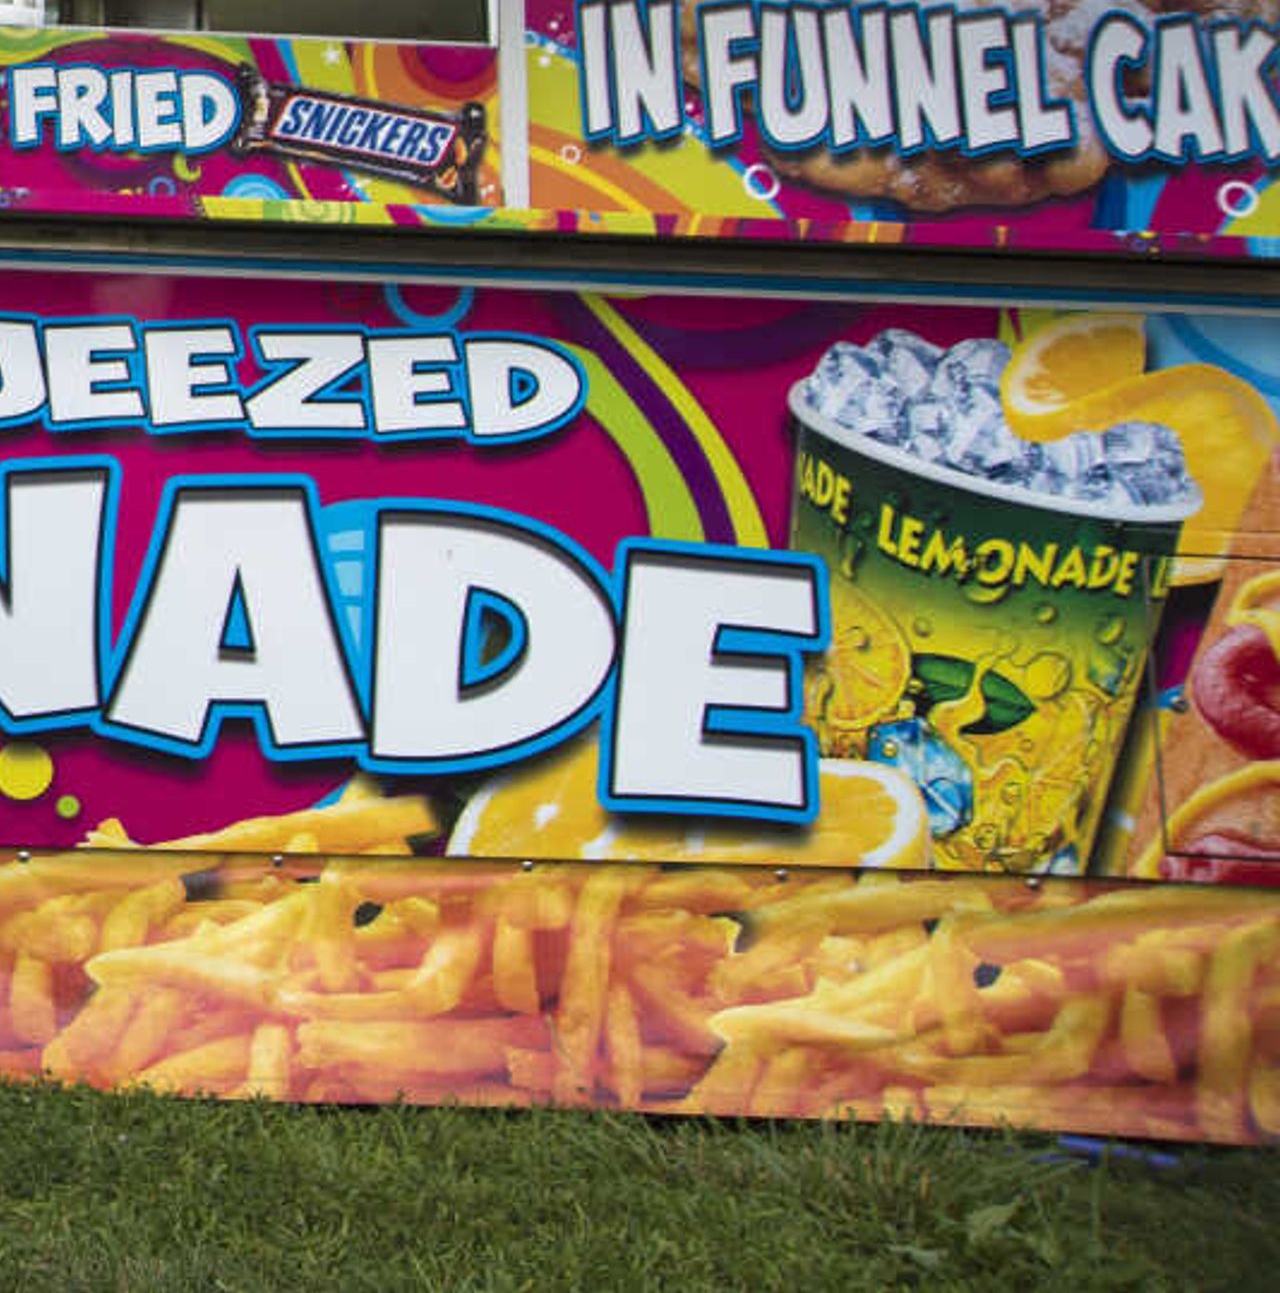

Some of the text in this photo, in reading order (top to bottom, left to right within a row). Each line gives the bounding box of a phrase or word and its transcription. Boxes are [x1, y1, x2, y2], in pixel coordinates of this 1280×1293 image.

[10, 63, 239, 152] FRIED
[700, 1, 1075, 151] FUNNEL
[281, 97, 452, 163] SNICKERS
[877, 503, 1138, 596] LEMONADE
